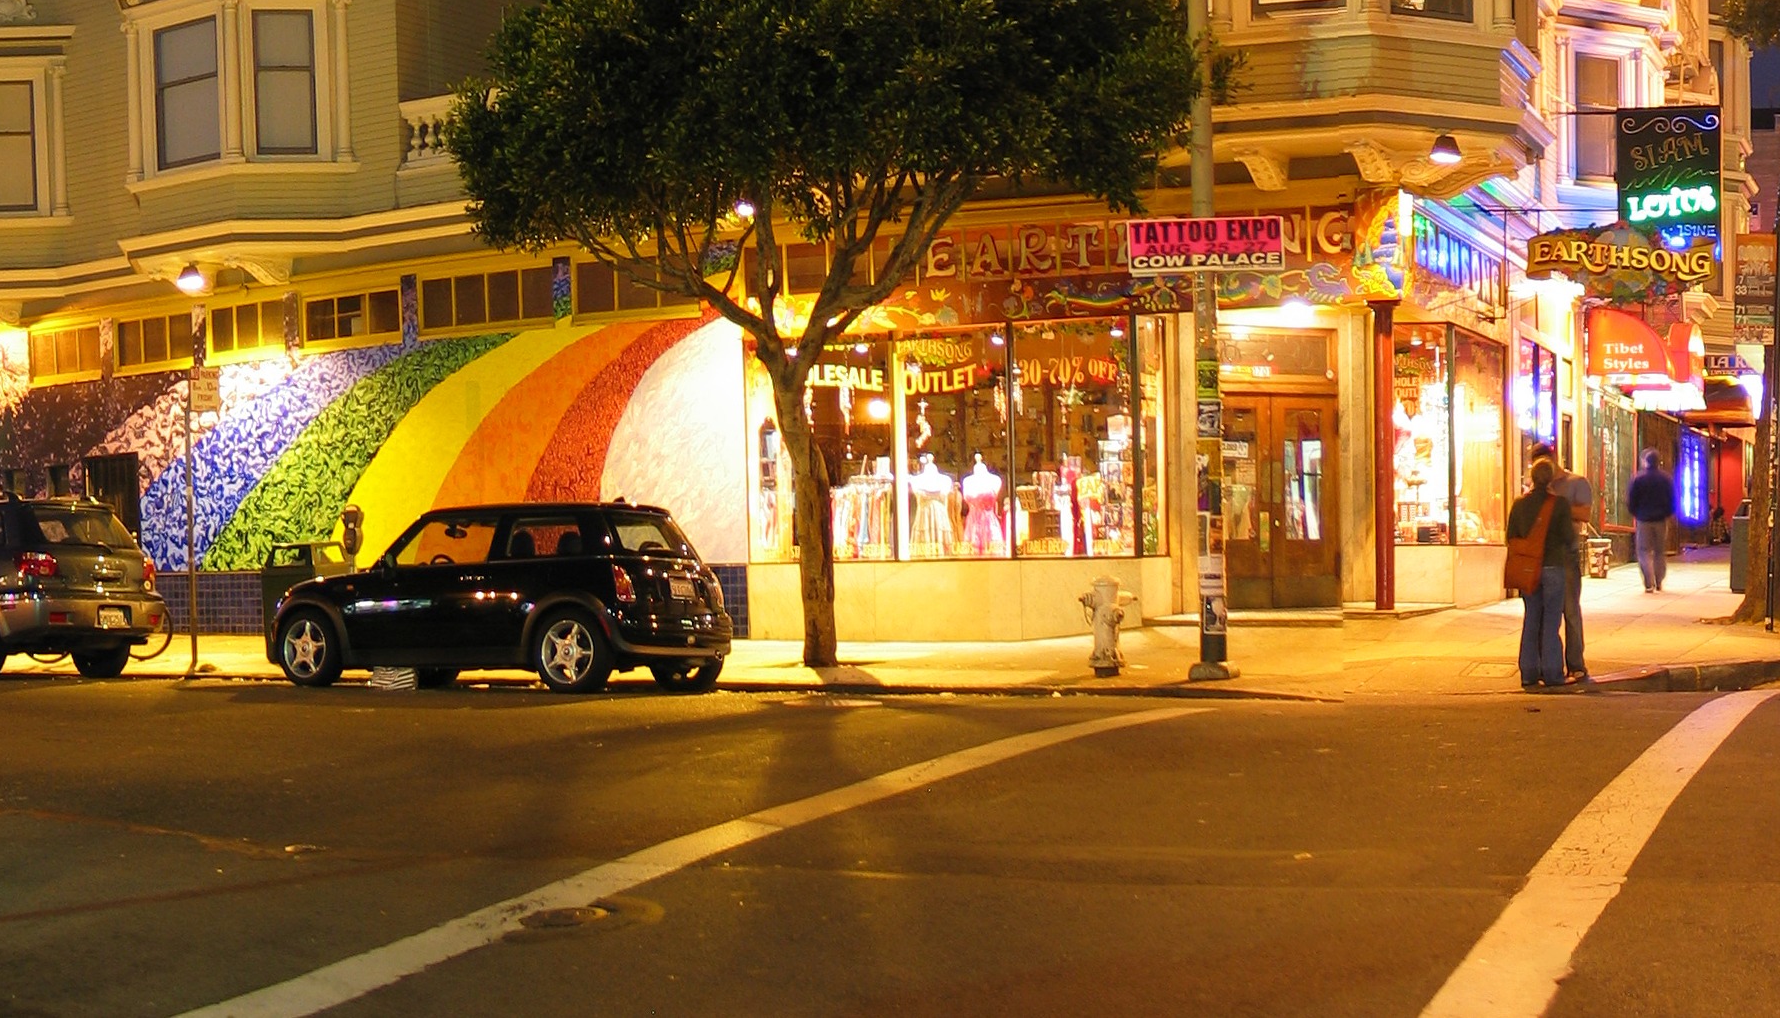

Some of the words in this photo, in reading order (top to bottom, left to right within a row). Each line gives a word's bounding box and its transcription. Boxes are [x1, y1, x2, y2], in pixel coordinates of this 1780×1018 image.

[1630, 132, 1710, 172] SIAM
[1131, 221, 1217, 245] TATTOO
[1226, 218, 1281, 241] EXPO
[1133, 255, 1186, 269] COW
[1191, 251, 1281, 267] PALACE
[1145, 243, 1191, 256] AUG
[1533, 240, 1713, 281] EARTHSONG
[1735, 285, 1748, 295] 33
[896, 338, 973, 365] EARTHSONG
[1602, 342, 1644, 355] Tibet
[1018, 356, 1085, 386] 30-70%
[1088, 358, 1118, 382] OFF
[1603, 357, 1650, 373] Styles
[1710, 355, 1729, 369] LA
[904, 363, 977, 396] OUTLET
